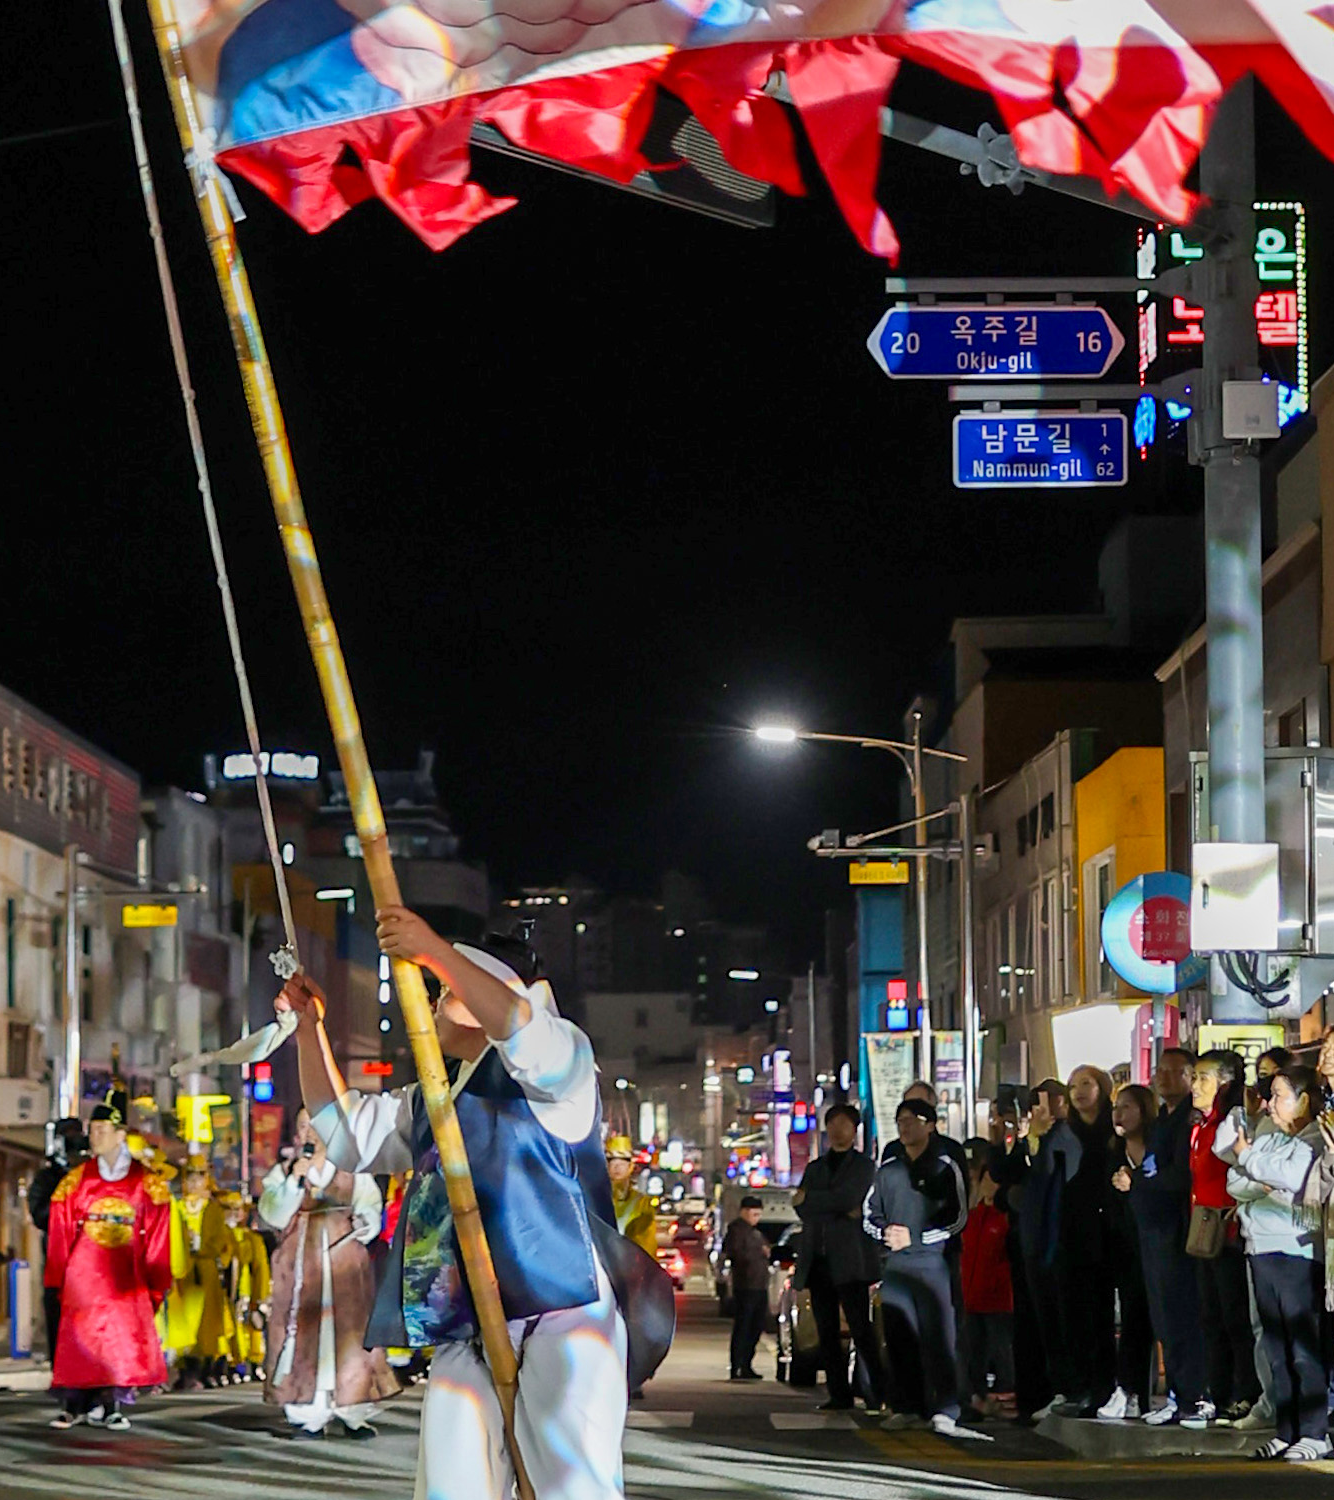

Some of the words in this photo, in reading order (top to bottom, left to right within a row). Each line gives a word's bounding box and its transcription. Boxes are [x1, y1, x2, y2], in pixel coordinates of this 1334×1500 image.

[950, 315, 1038, 346] 옥주길
[890, 332, 921, 354] 20
[1075, 331, 1102, 353] 16
[956, 351, 1033, 374] Okju-gil
[981, 423, 1072, 454] 남문길
[1101, 423, 1108, 438] 1
[972, 458, 1083, 481] Nammun-gil
[1096, 462, 1116, 477] 62
